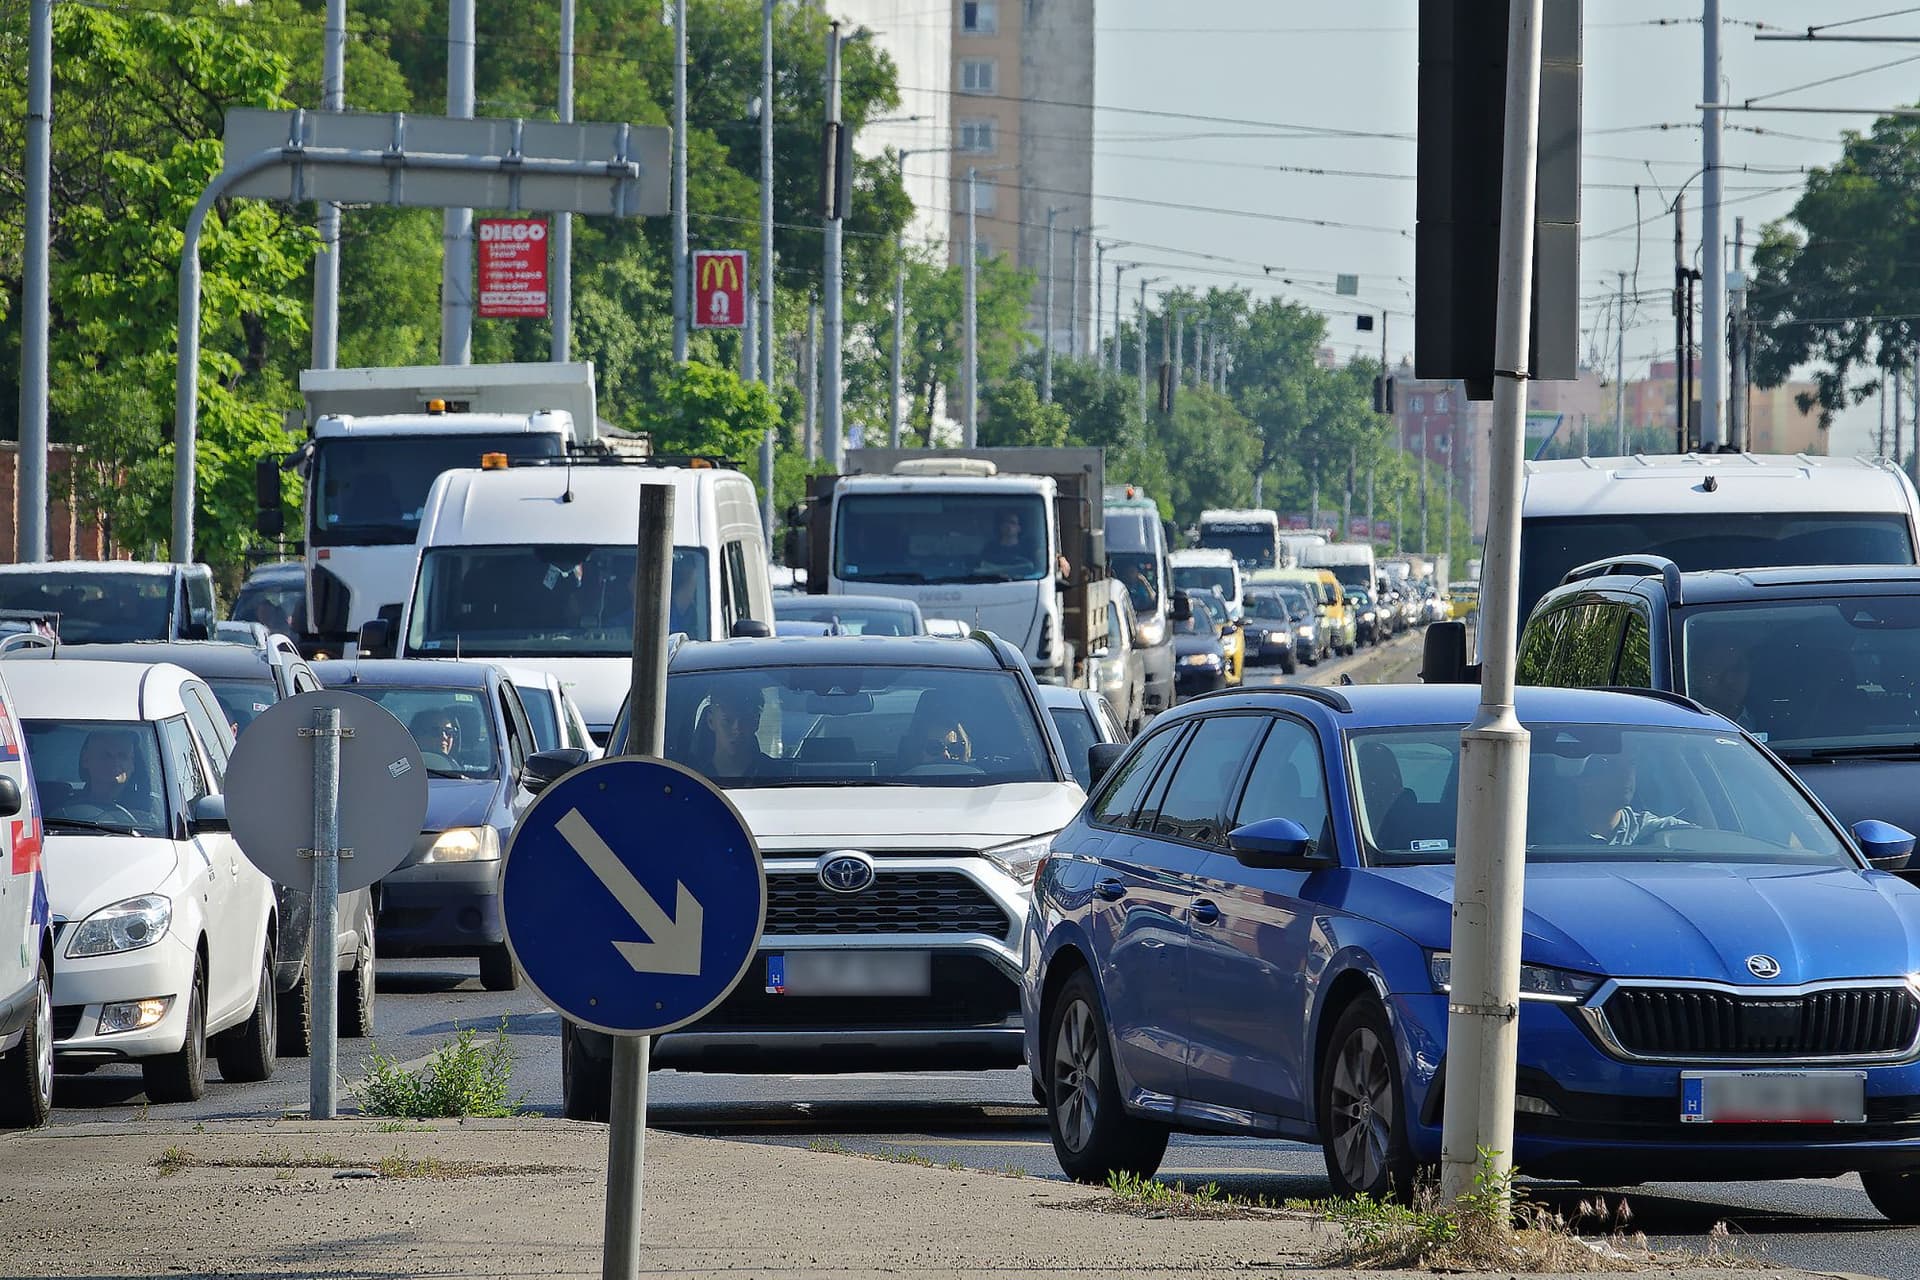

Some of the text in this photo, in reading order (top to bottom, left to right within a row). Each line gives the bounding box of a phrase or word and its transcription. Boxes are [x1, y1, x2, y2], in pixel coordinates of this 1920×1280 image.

[480, 224, 545, 241] DIEGO
[772, 974, 781, 985] H
[1688, 1100, 1697, 1111] H
